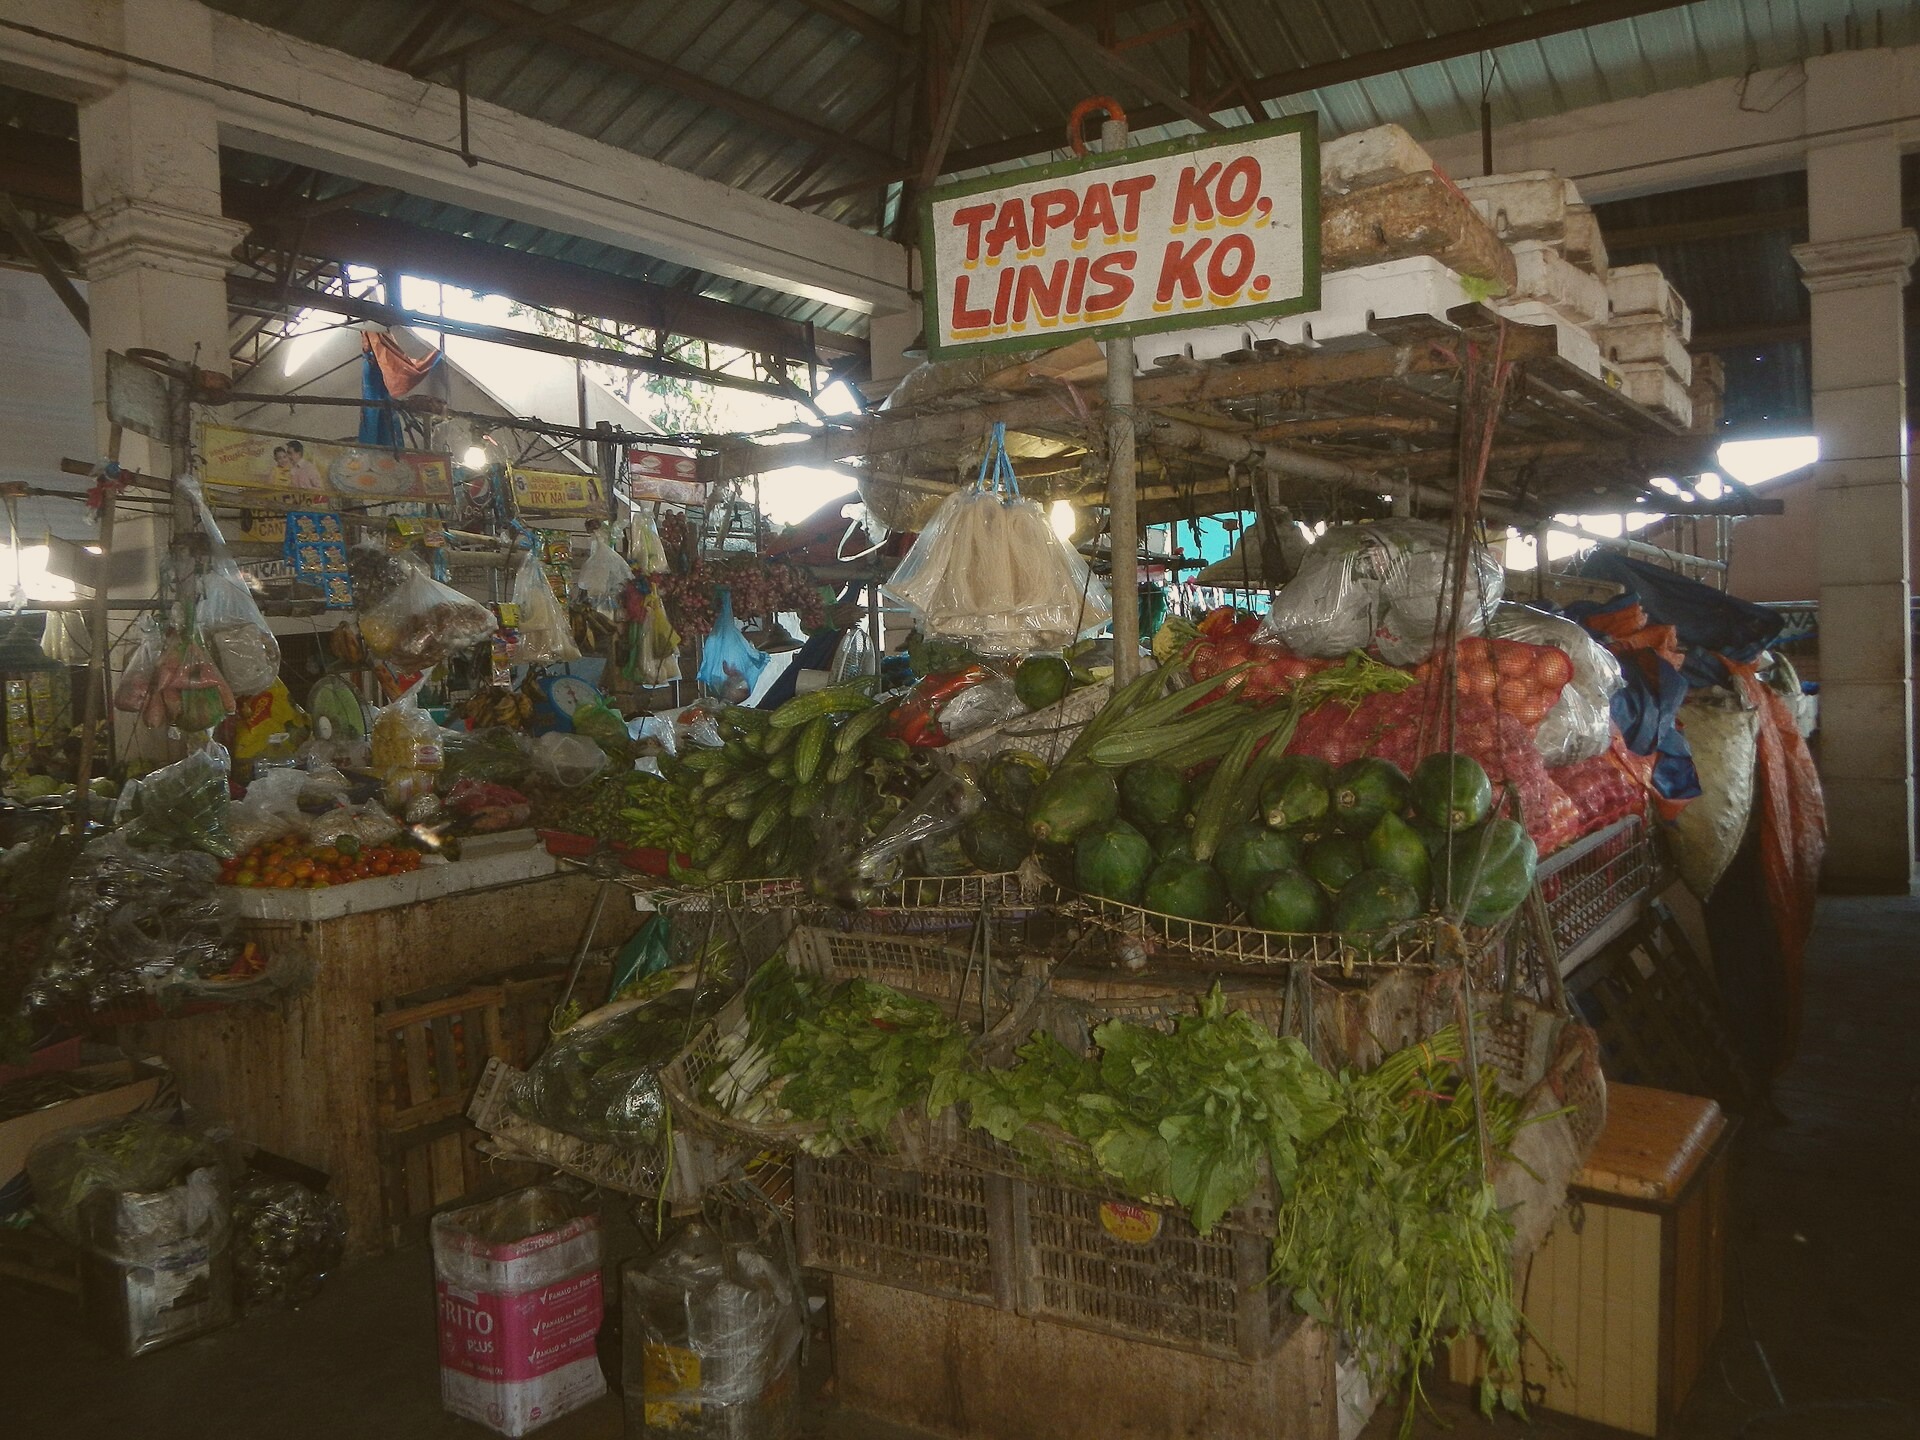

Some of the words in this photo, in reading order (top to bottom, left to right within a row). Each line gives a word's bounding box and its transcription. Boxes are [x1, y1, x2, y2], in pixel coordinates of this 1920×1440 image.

[952, 174, 1156, 267] TAPAT
[1170, 156, 1273, 232] KO,
[951, 250, 1138, 340] LINIS
[1153, 233, 1271, 311] KO.
[530, 491, 546, 504] TRY
[550, 491, 566, 504] NA!
[467, 1339, 494, 1354] PLUS
